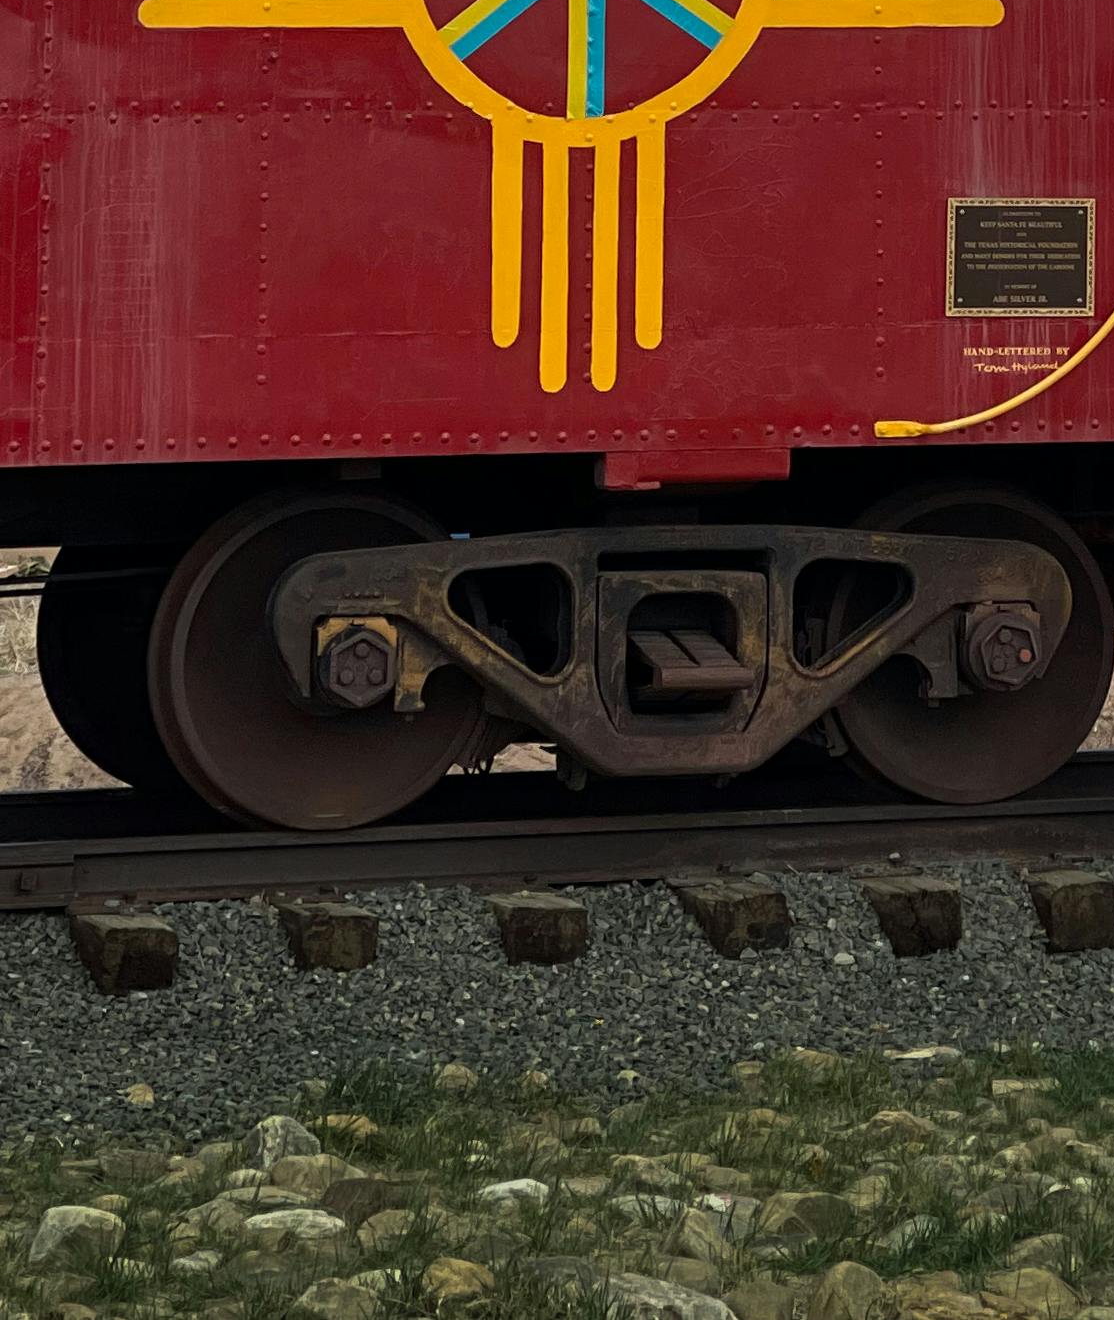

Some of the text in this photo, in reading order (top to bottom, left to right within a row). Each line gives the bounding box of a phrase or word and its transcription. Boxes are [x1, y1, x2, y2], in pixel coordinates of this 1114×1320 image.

[963, 347, 1070, 356] HAND-LETTERED BY
[973, 363, 1009, 373] Tom
